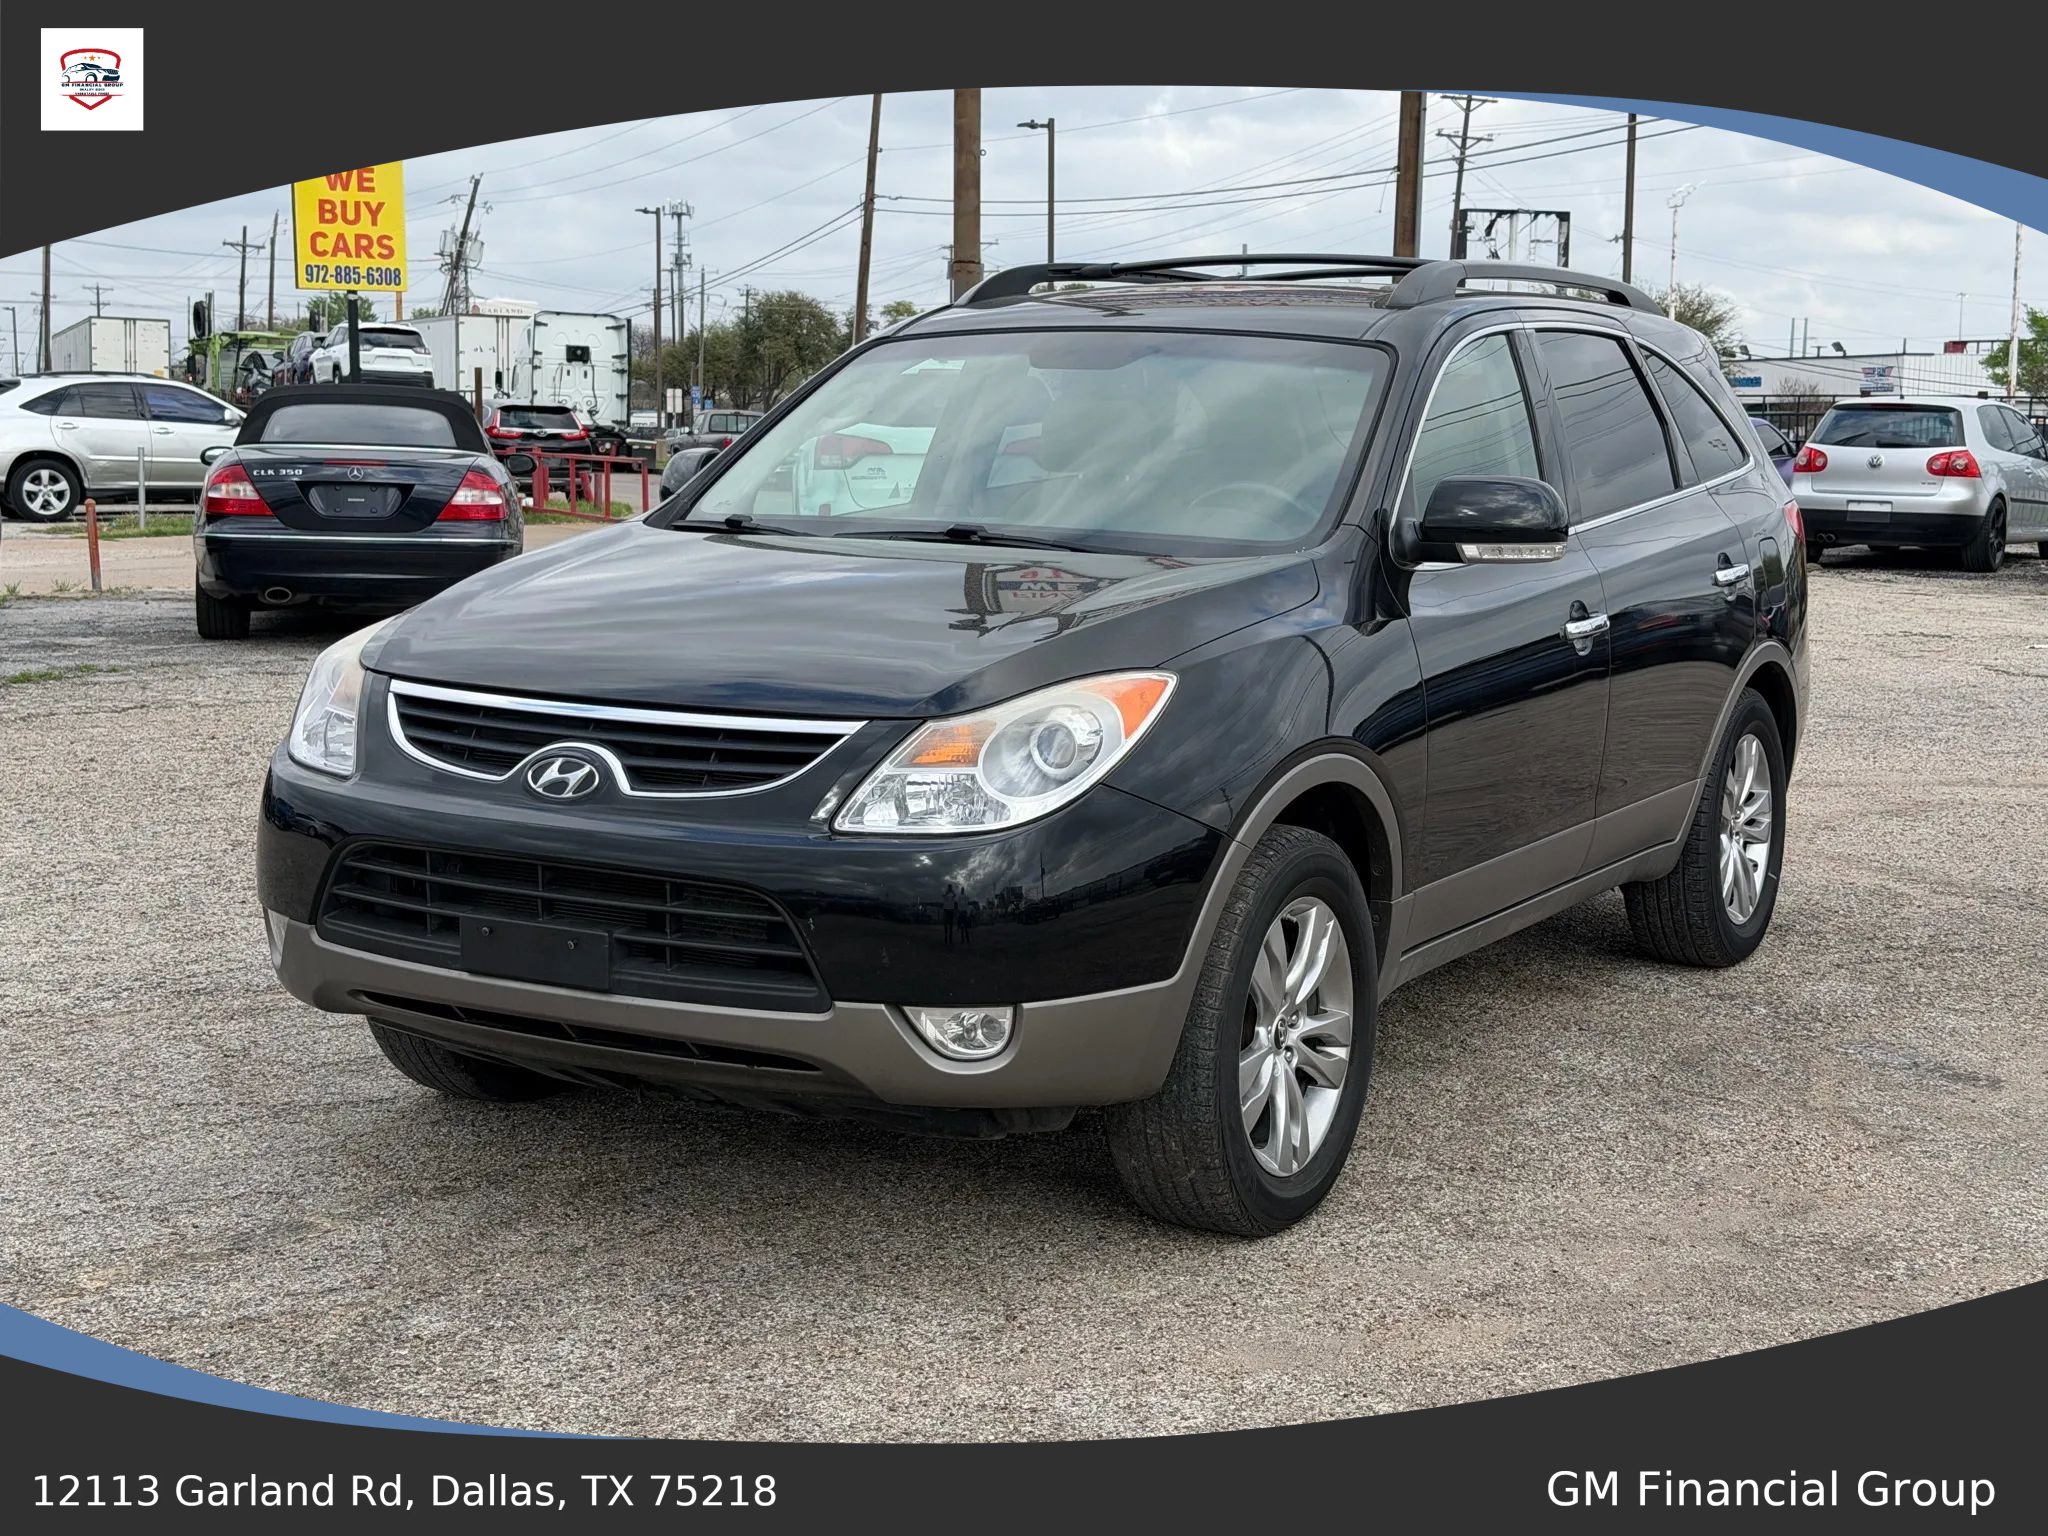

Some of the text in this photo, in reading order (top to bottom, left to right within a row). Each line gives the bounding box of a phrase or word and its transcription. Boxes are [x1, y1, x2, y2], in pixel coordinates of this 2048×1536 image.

[324, 167, 375, 193] WE
[318, 198, 386, 227] BUY
[310, 231, 395, 260] CARS
[305, 264, 401, 286] 972-885-6308
[279, 468, 303, 476] 350
